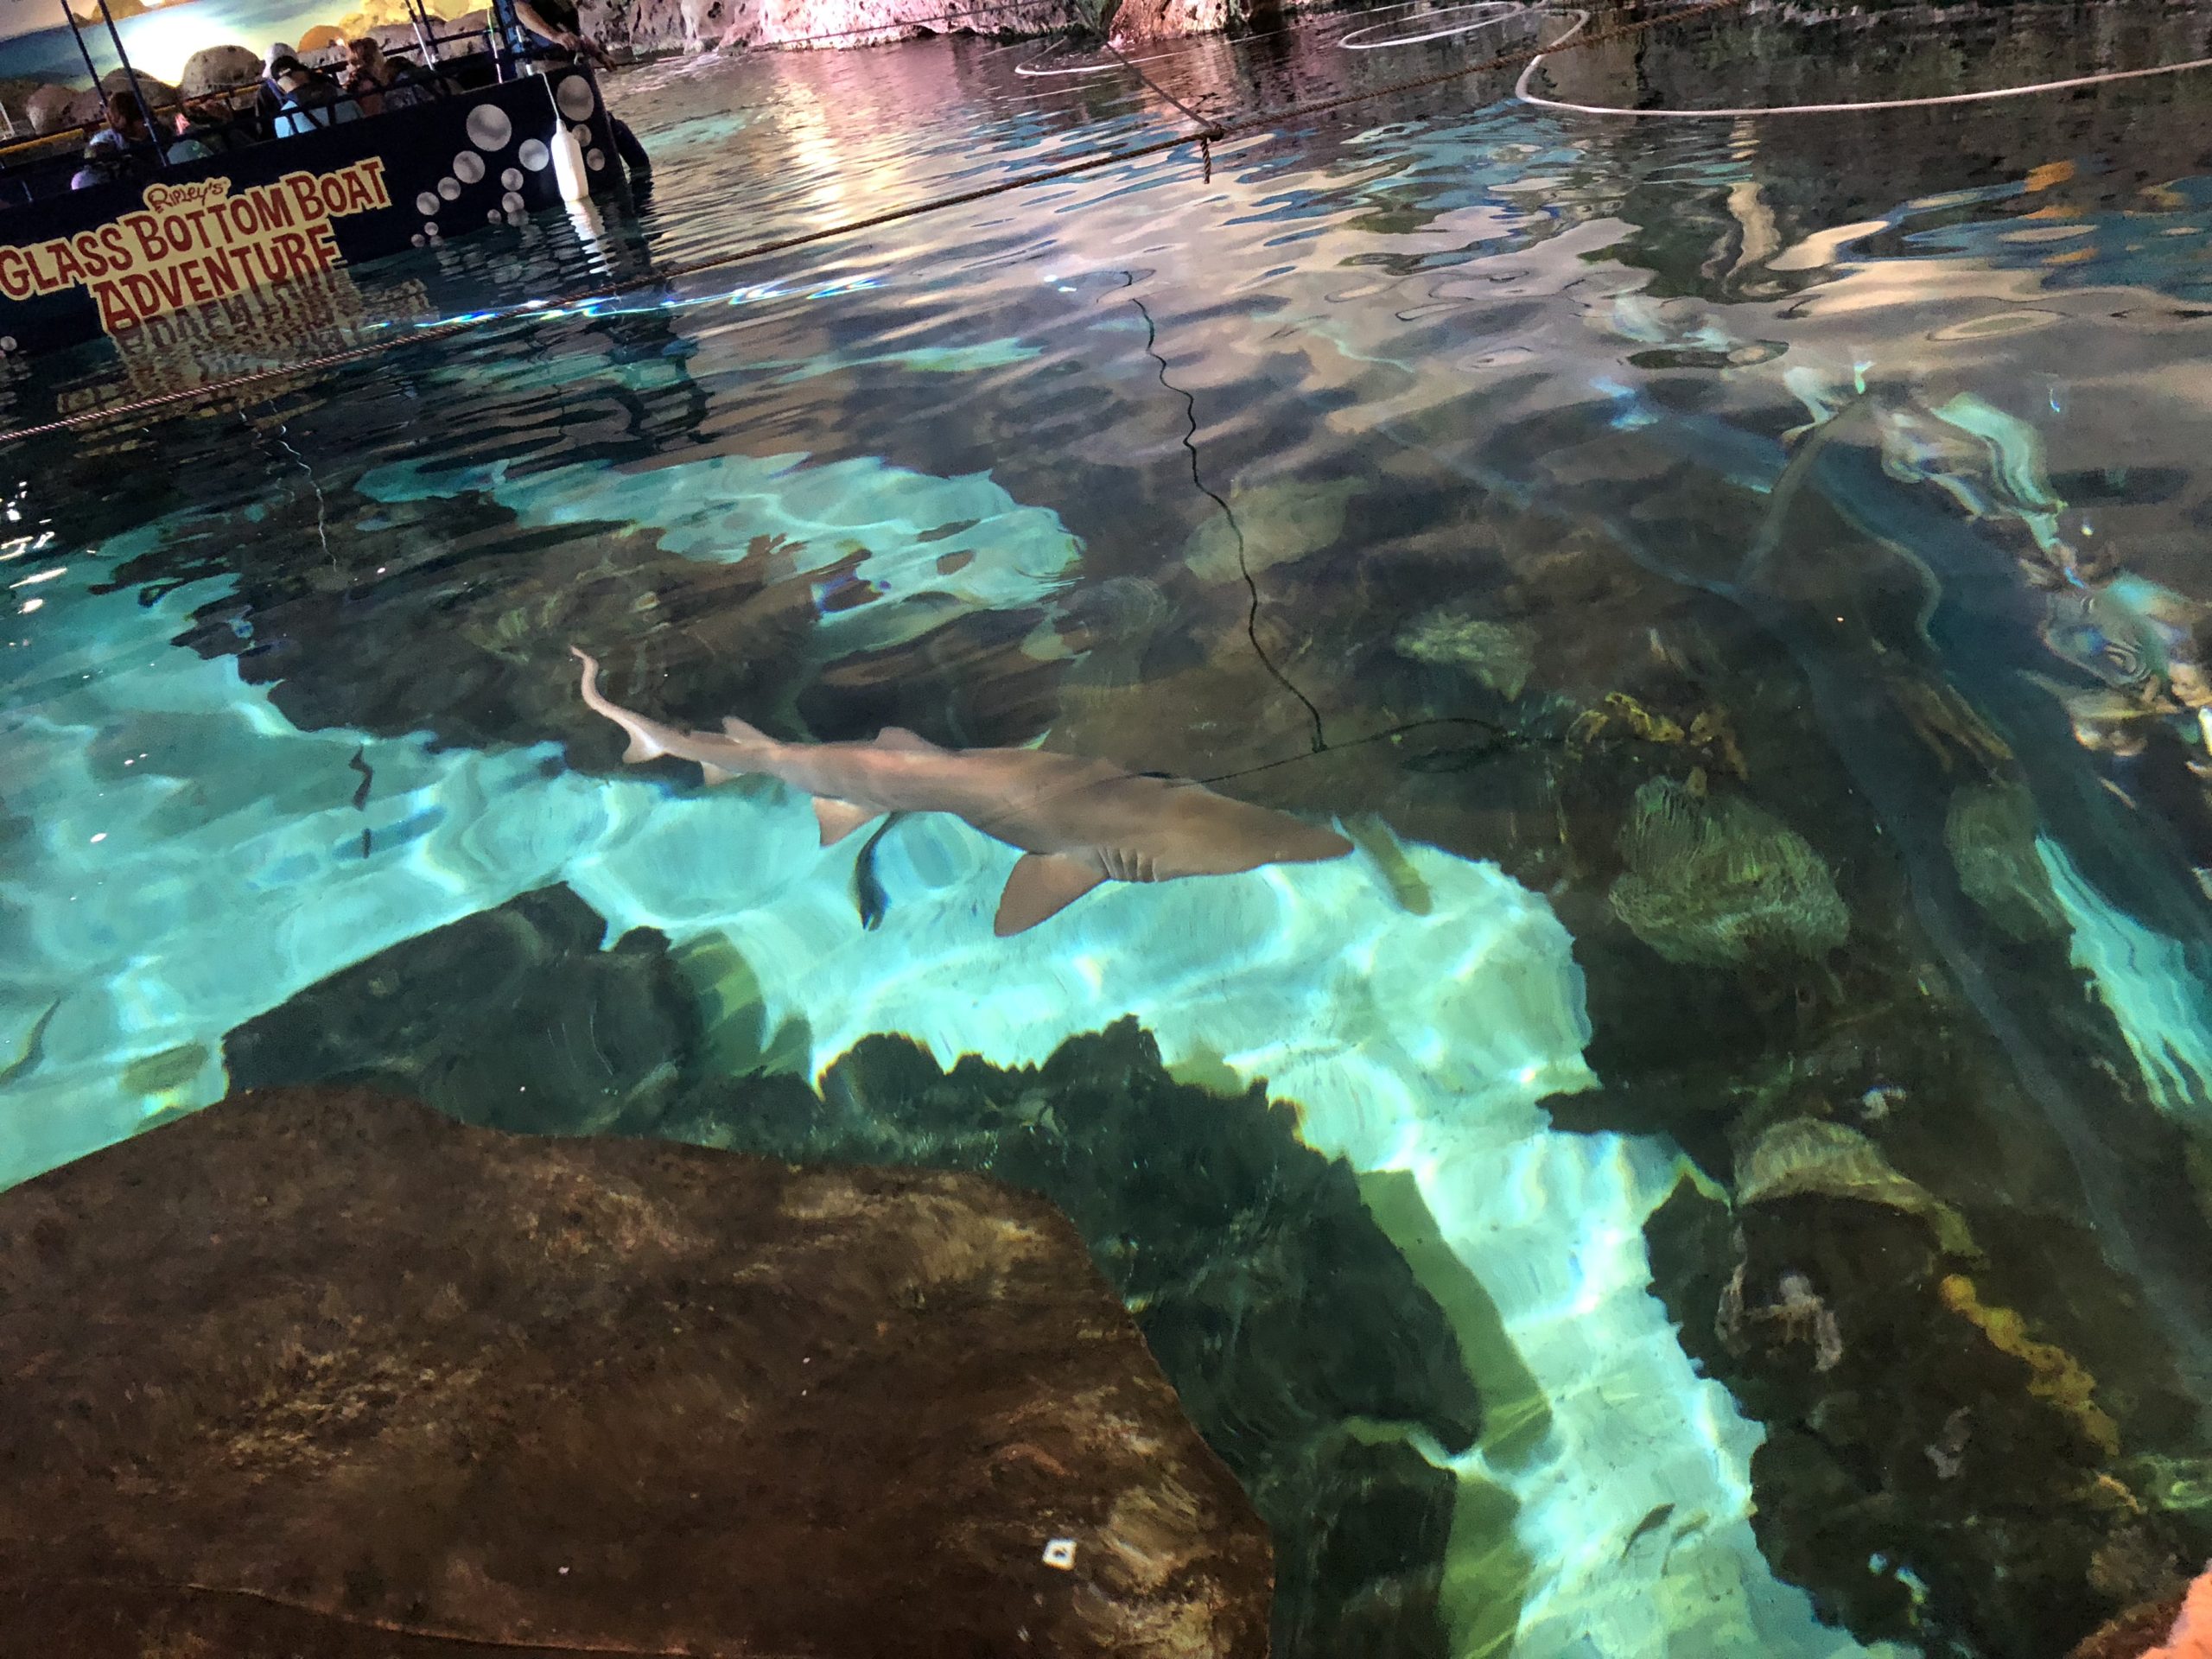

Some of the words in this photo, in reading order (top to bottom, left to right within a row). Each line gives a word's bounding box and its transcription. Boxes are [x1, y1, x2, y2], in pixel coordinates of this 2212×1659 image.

[0, 227, 132, 296] GLASS
[125, 188, 295, 262] BOTTOM
[286, 162, 387, 221] BOAT
